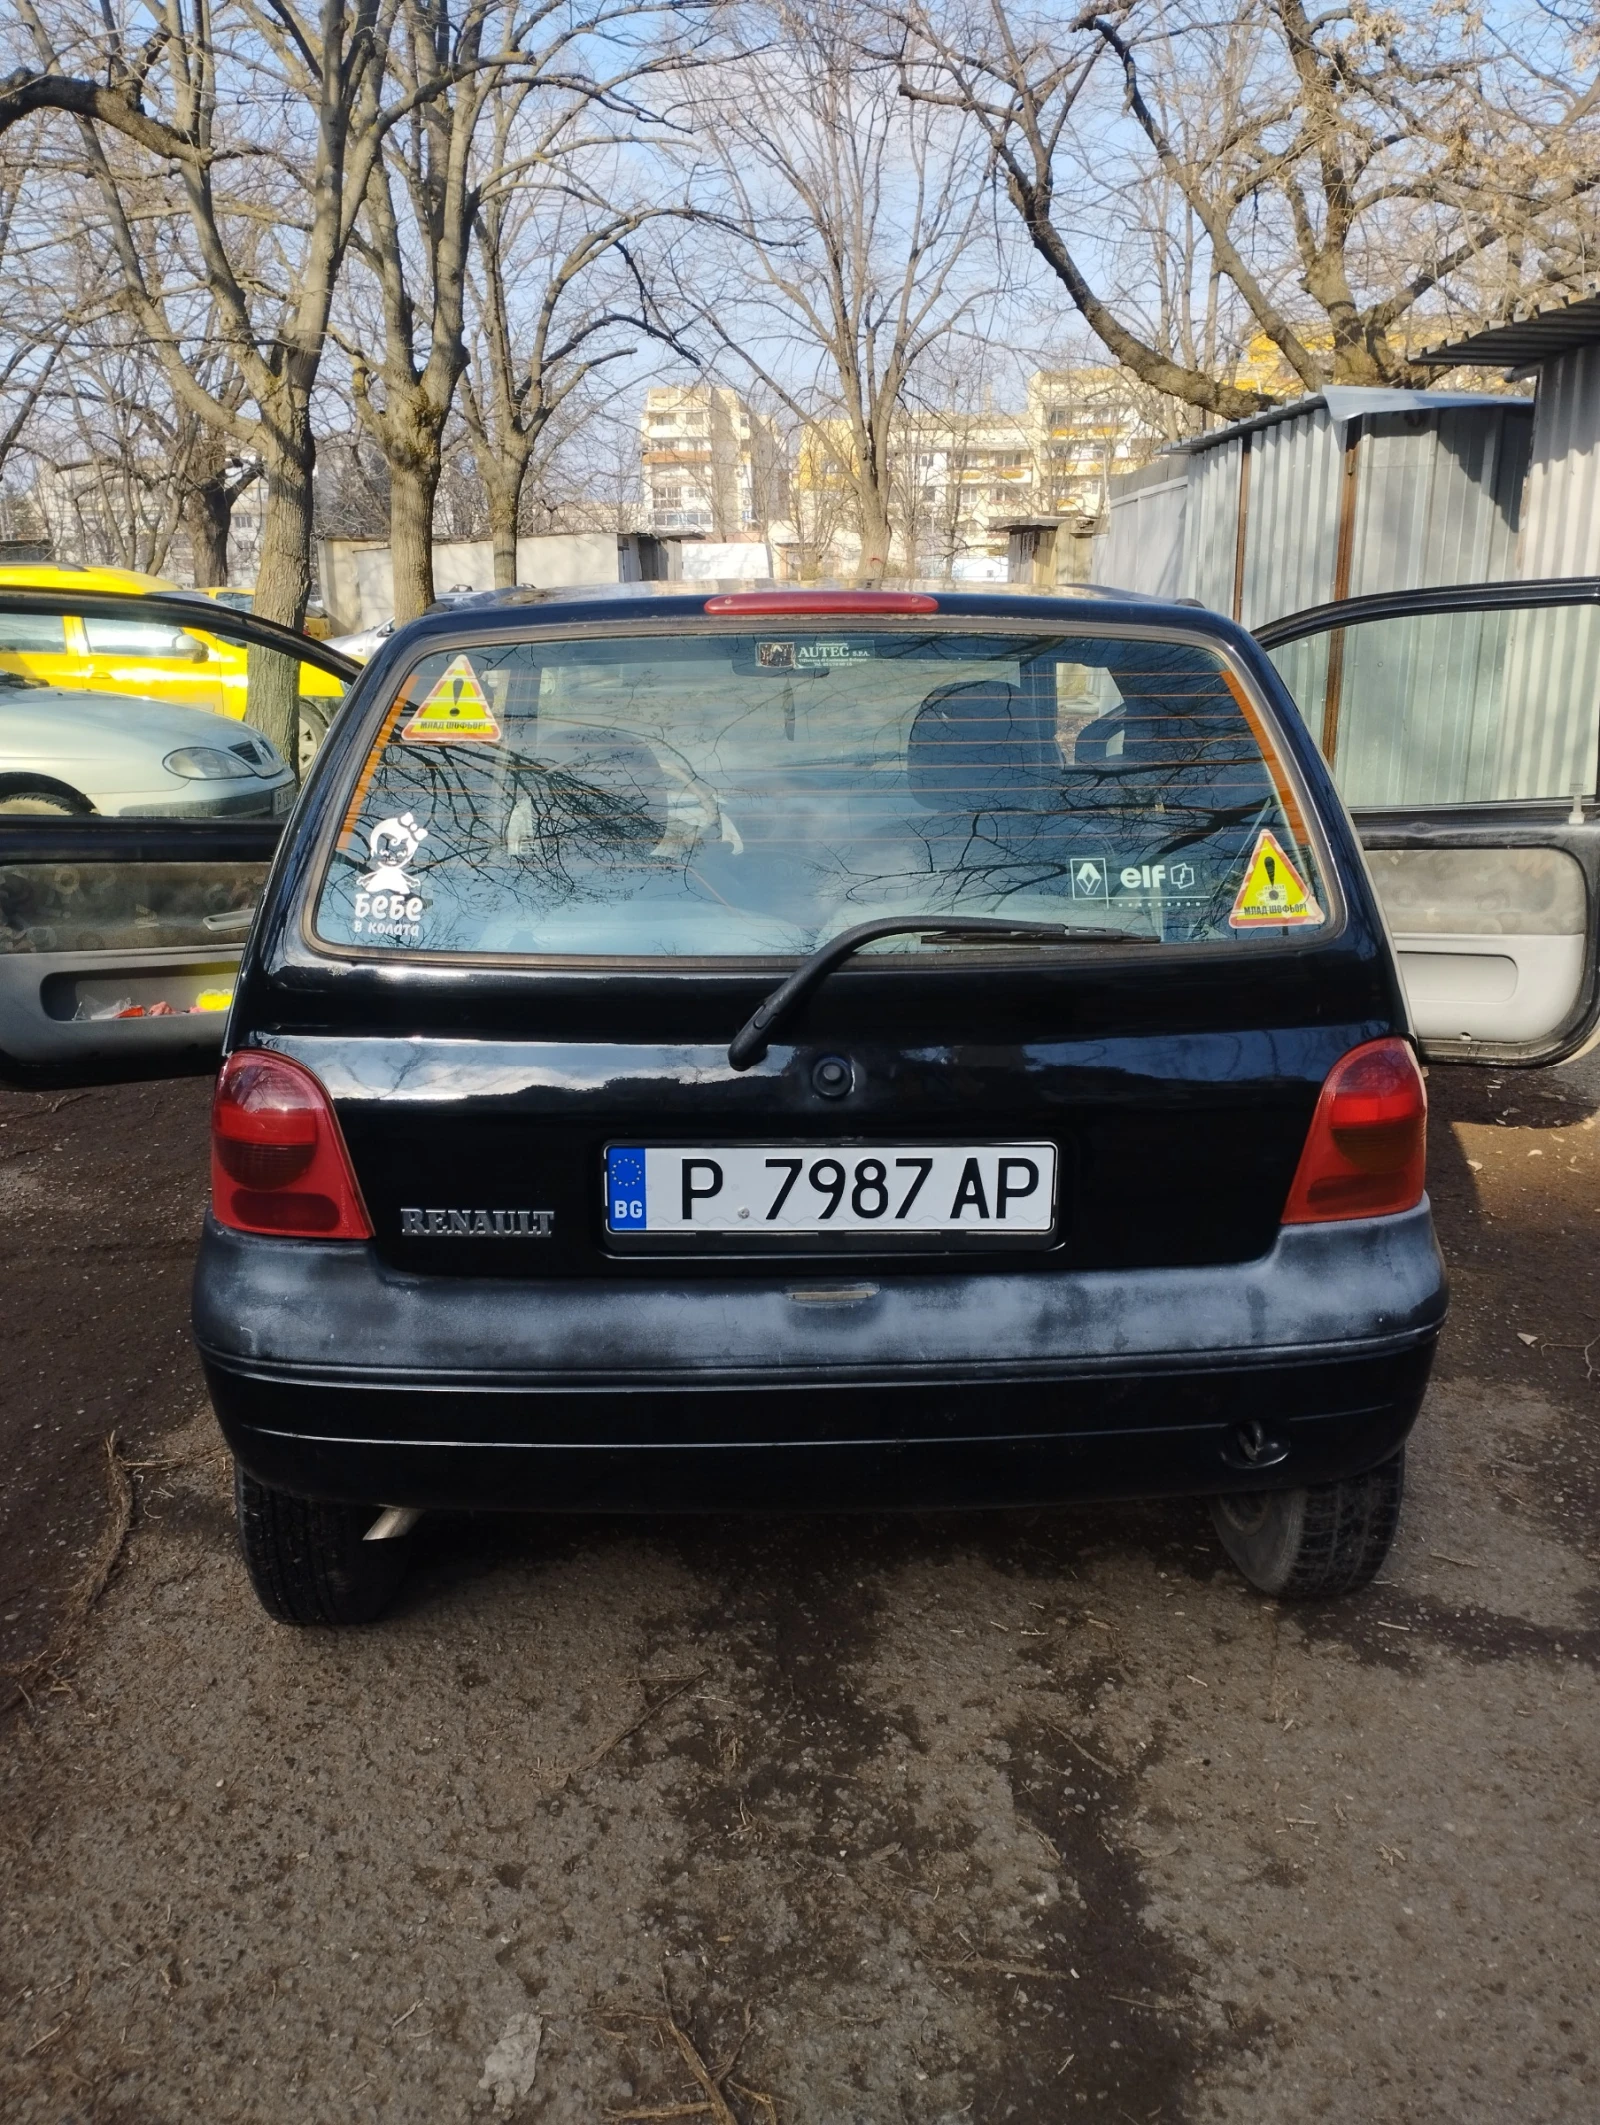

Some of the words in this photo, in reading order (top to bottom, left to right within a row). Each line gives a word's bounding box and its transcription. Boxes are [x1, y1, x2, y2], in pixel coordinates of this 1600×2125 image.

[798, 646, 849, 657] AUTEC
[420, 721, 444, 731] МЛАД
[1120, 865, 1166, 888] elf
[1243, 906, 1268, 916] МЛАД
[367, 922, 420, 936] колата
[681, 1158, 724, 1220] P
[765, 1157, 933, 1220] 7987
[949, 1157, 1040, 1219] AP
[613, 1200, 643, 1219] BG
[400, 1208, 555, 1237] RENAULT
